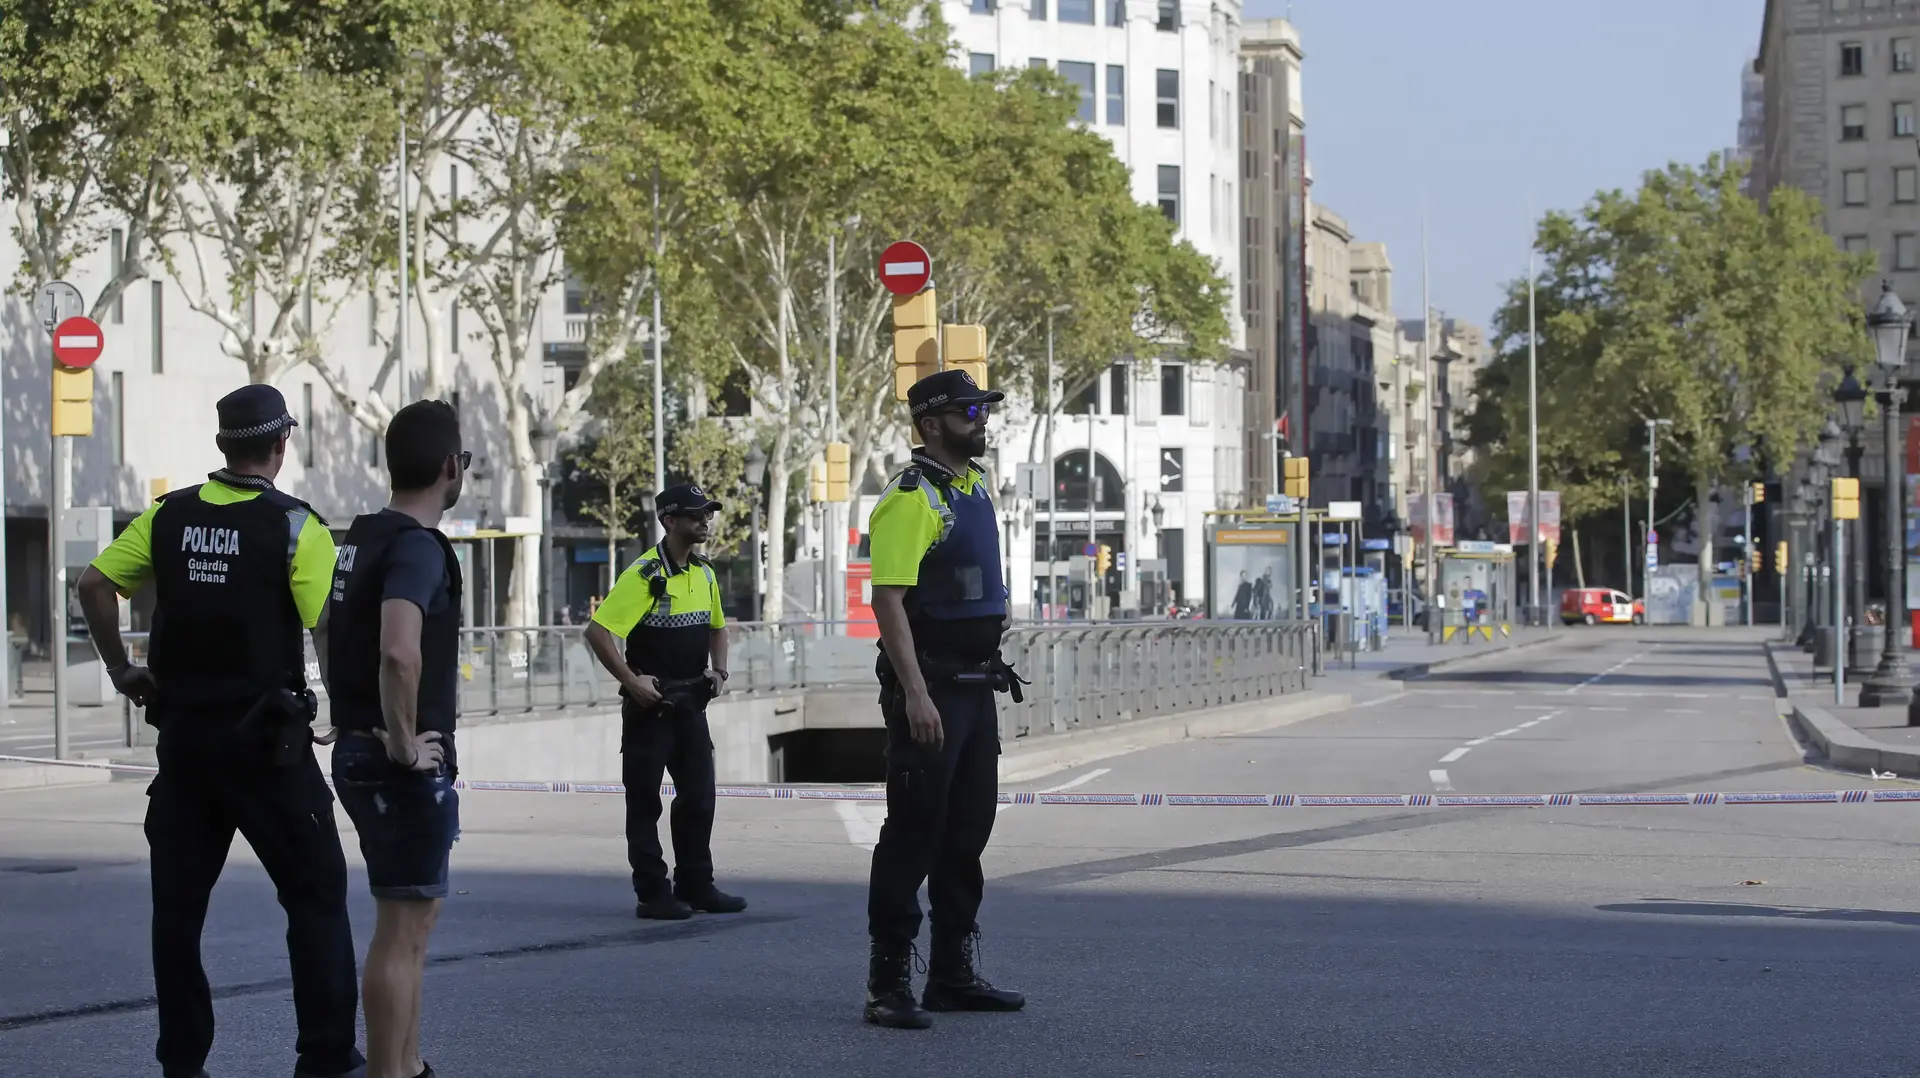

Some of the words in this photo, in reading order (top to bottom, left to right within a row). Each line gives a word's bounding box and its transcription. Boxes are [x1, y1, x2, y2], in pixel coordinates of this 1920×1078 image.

[928, 394, 948, 404] POLICIA
[181, 526, 240, 555] POLICIA
[187, 558, 229, 572] Guàrdia
[189, 570, 226, 583] Urbana
